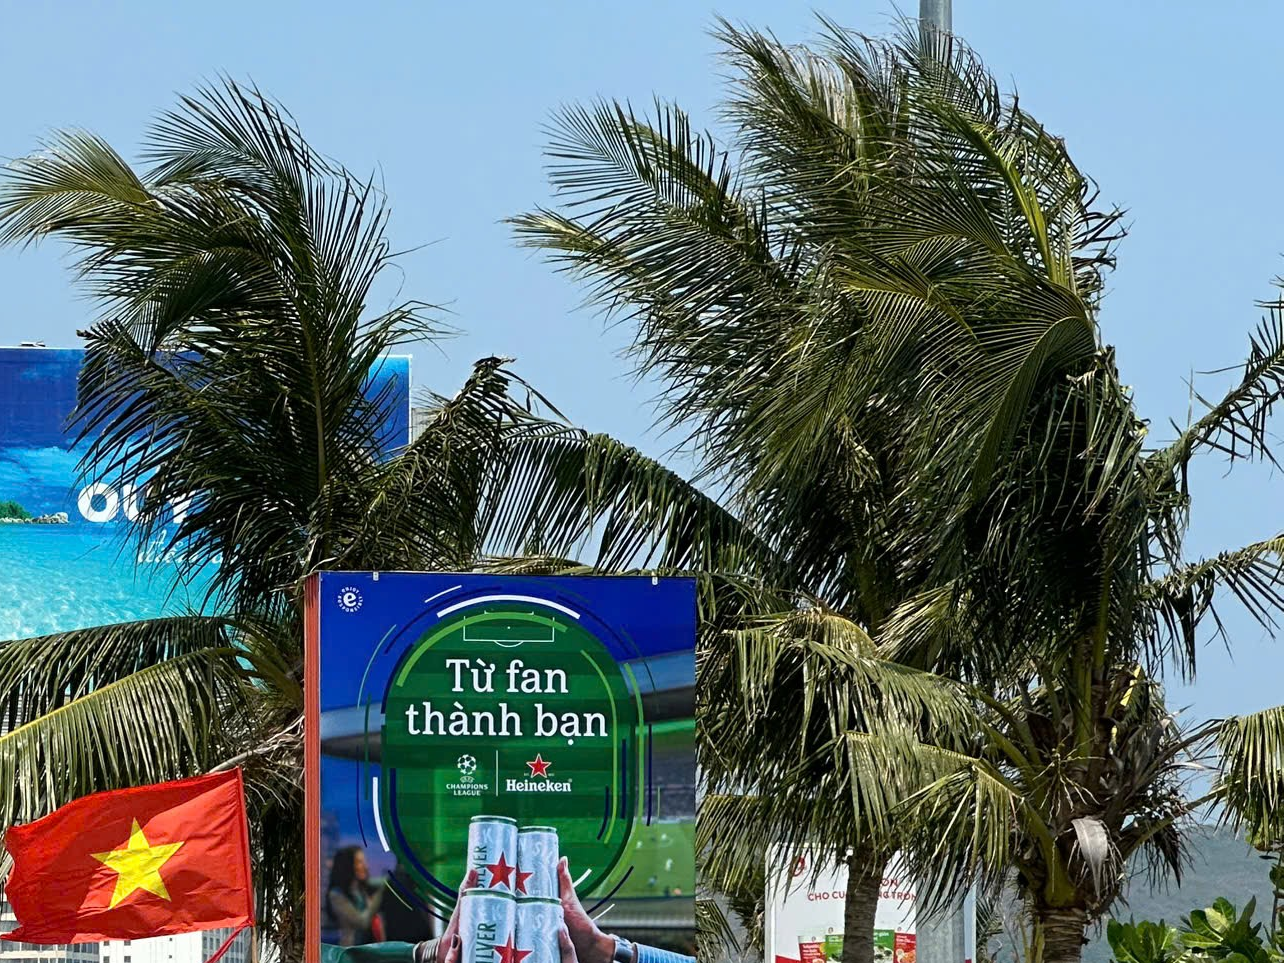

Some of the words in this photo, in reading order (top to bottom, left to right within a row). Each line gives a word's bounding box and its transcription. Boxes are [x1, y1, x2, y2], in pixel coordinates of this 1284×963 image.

[445, 657, 496, 692] Từ
[505, 658, 569, 694] fan
[404, 700, 524, 736] thành
[534, 703, 609, 746] bạn
[506, 778, 572, 792] Heineken
[807, 892, 830, 902] CHO
